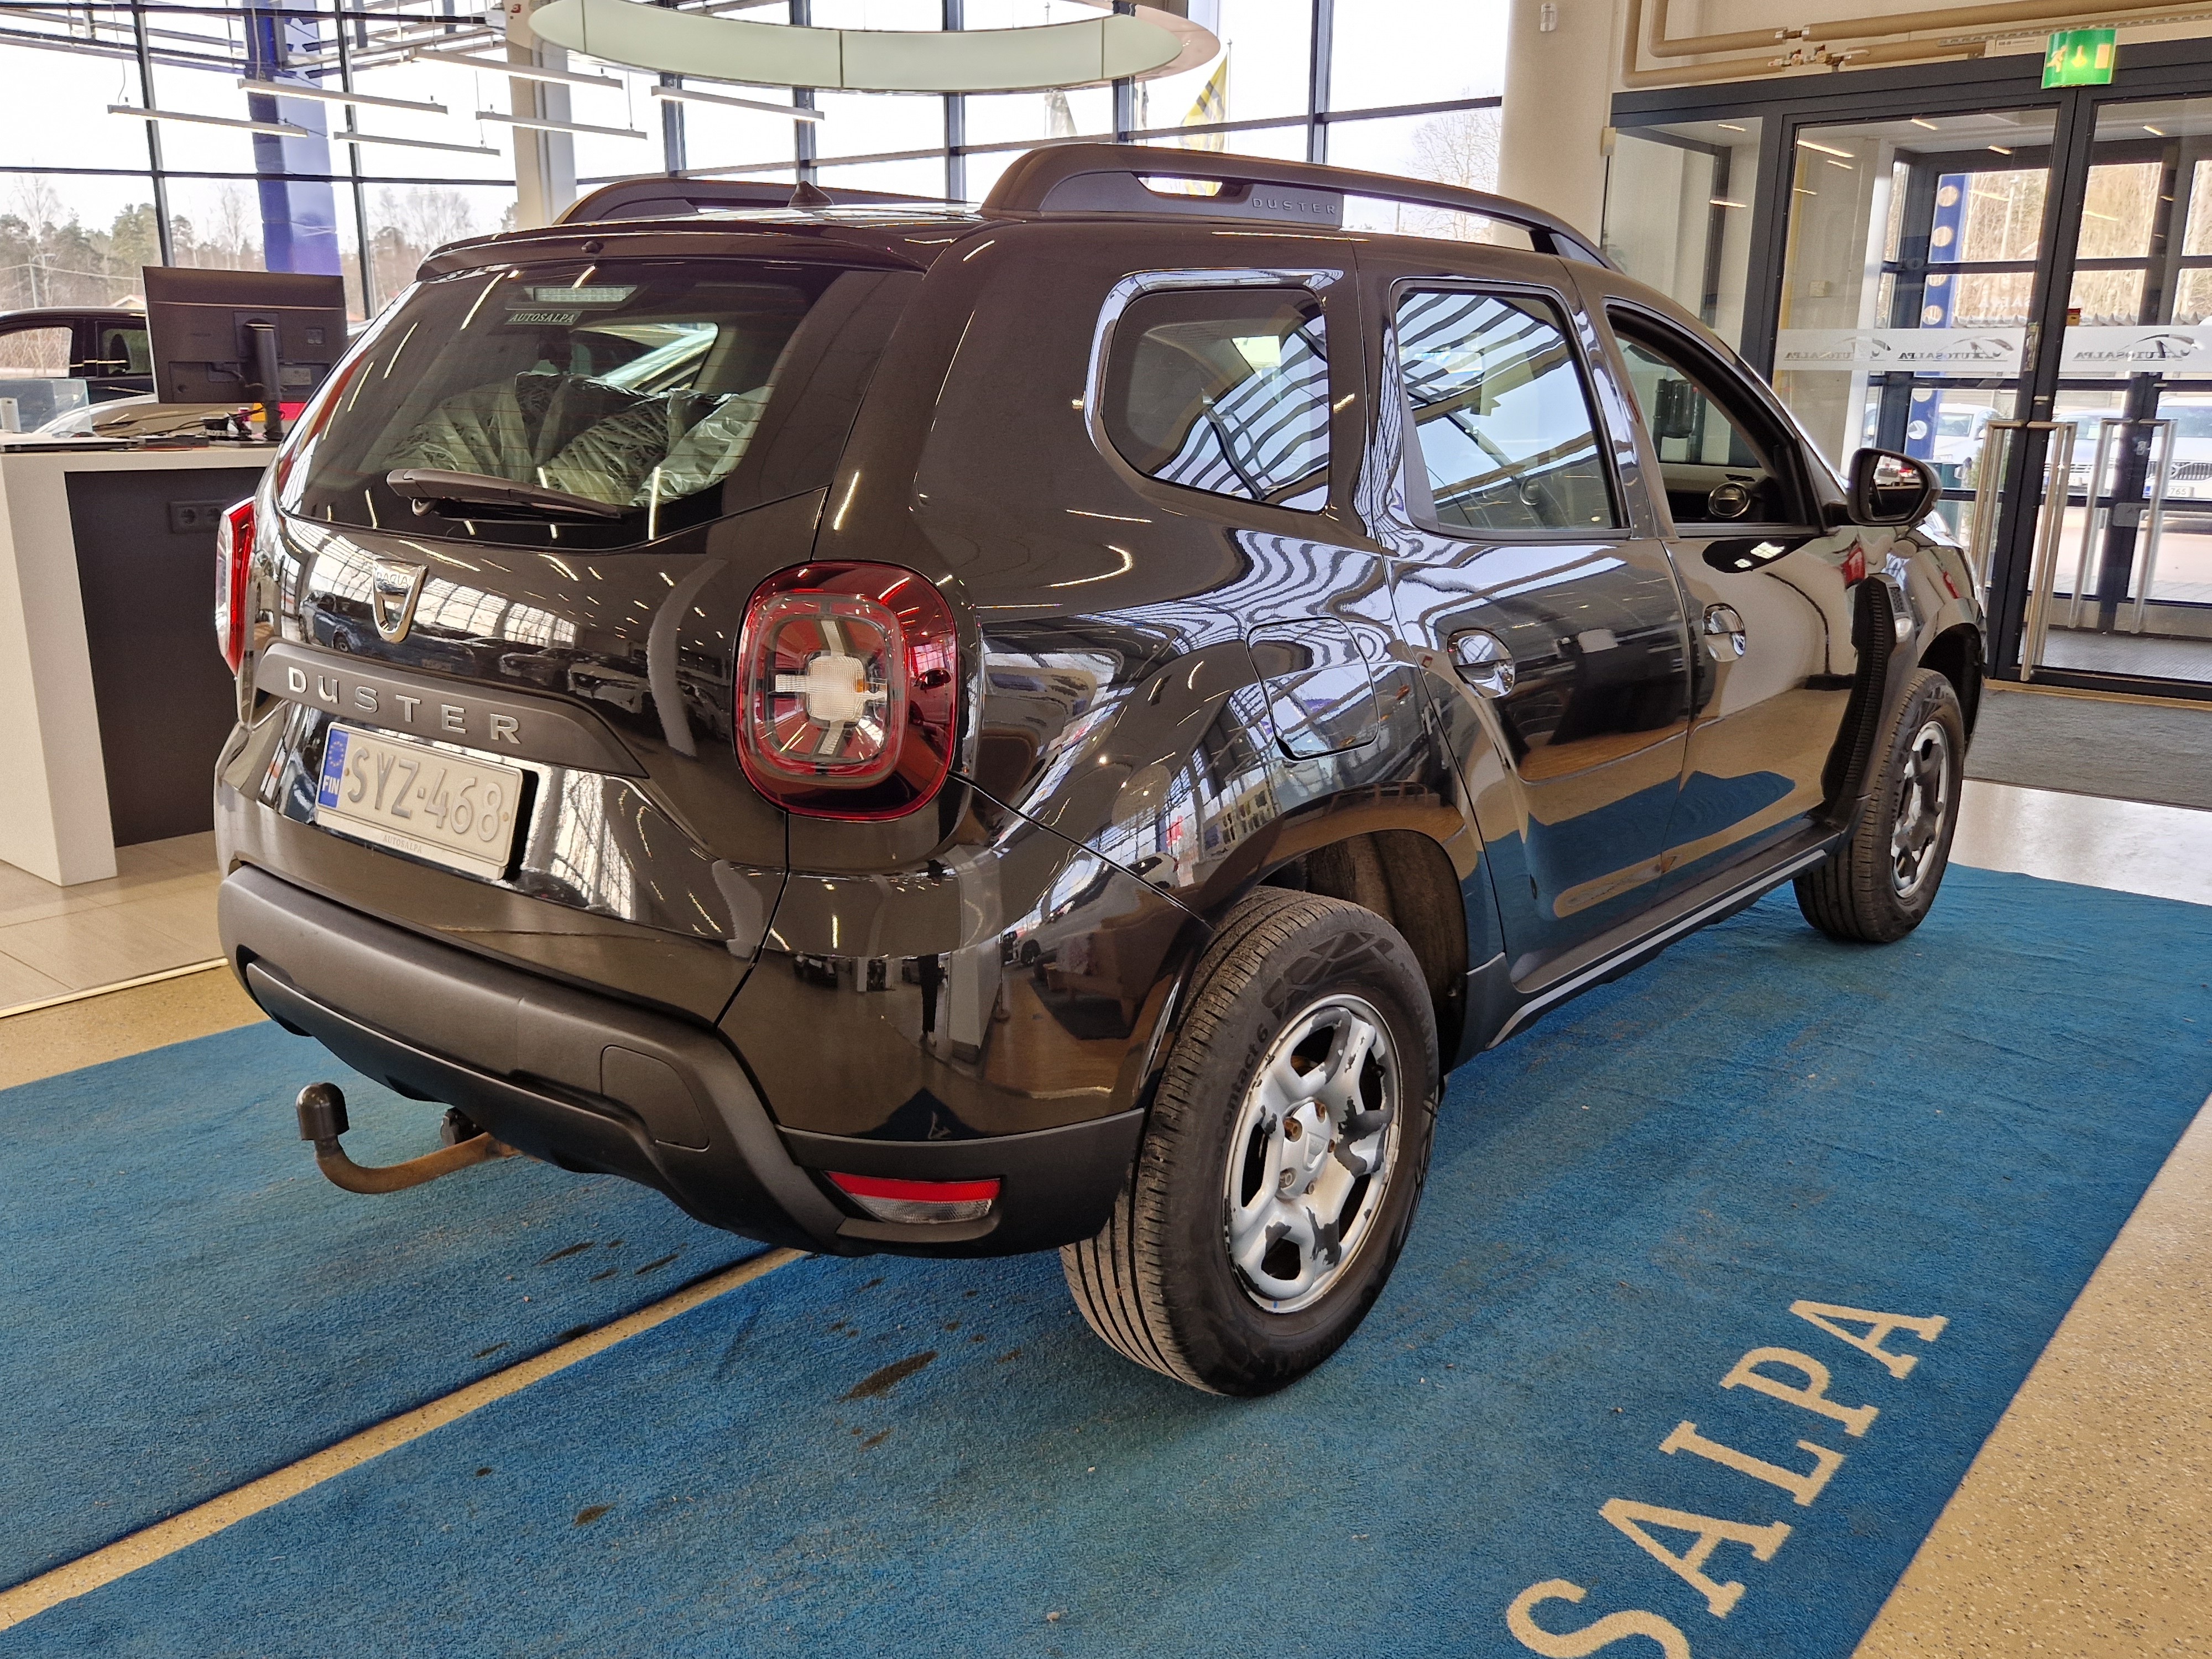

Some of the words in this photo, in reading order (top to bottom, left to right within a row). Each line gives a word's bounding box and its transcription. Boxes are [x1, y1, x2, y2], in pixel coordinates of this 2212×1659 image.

[1252, 197, 1335, 215] DUSTER
[509, 312, 575, 323] AUTOSALPA
[376, 571, 409, 587] DACIA
[288, 665, 521, 744] DUSTER
[322, 775, 341, 795] FIN
[347, 747, 502, 842] SYZ-468
[382, 834, 422, 853] AUTOSALPA
[1506, 1299, 1950, 1659] SALPA
